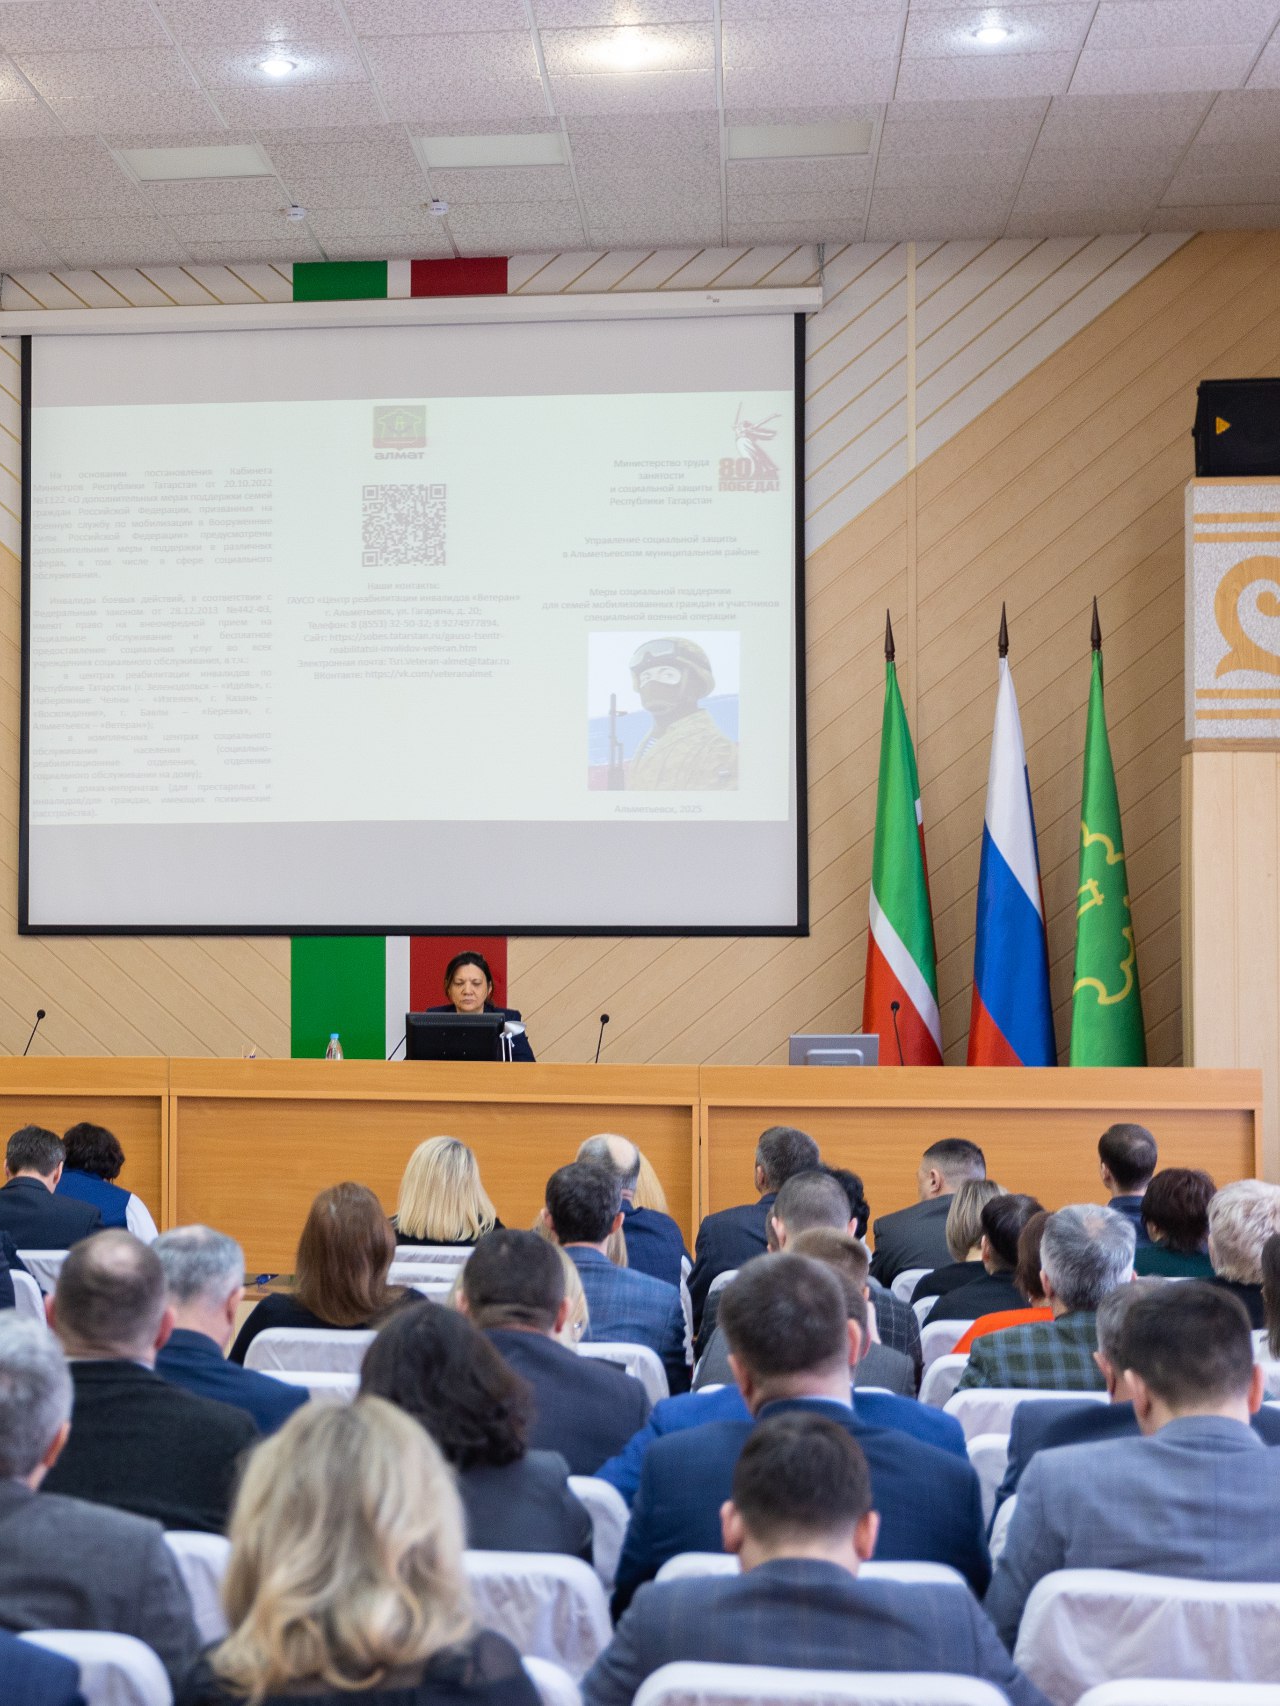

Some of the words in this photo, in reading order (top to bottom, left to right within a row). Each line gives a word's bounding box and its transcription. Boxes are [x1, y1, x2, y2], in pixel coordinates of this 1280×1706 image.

[613, 459, 681, 469] Министерство
[683, 460, 709, 468] труда
[719, 457, 753, 479] 80
[617, 483, 674, 495] социальной
[677, 485, 712, 494] защиты
[719, 480, 781, 494] ПОБЕДА!
[609, 496, 664, 507] Республики
[667, 496, 712, 506] Татарстан
[584, 535, 640, 545] Управление
[641, 534, 699, 545] социальной
[701, 536, 737, 544] защиты
[569, 549, 643, 557] Альметьевском
[644, 550, 722, 558] муниципальном
[723, 547, 760, 558] районе
[367, 582, 392, 590] Наши
[588, 587, 617, 597] Меры
[618, 586, 675, 597] социальной
[677, 588, 731, 596] поддержки
[286, 596, 315, 604] ГАУСО
[316, 595, 350, 605] «Центр
[351, 594, 417, 605] реабилитации
[419, 595, 470, 604] инвалидов
[471, 593, 520, 603] «Ветеран»
[560, 600, 590, 609] семей
[591, 599, 673, 608] мобилизованных
[675, 601, 715, 610] граждан
[725, 601, 779, 609] участников
[332, 608, 394, 618] Альметьевск,
[411, 607, 454, 617] Гагарина,
[583, 612, 645, 623] специальной
[647, 611, 687, 620] военной
[689, 613, 736, 622] операции
[308, 620, 348, 630] Телефон:
[303, 632, 327, 641] Сайт:
[296, 659, 355, 669] Электронная
[313, 671, 362, 679] ВКонтакте:
[614, 805, 676, 815] Альметьевск,
[679, 805, 702, 813] 2025
